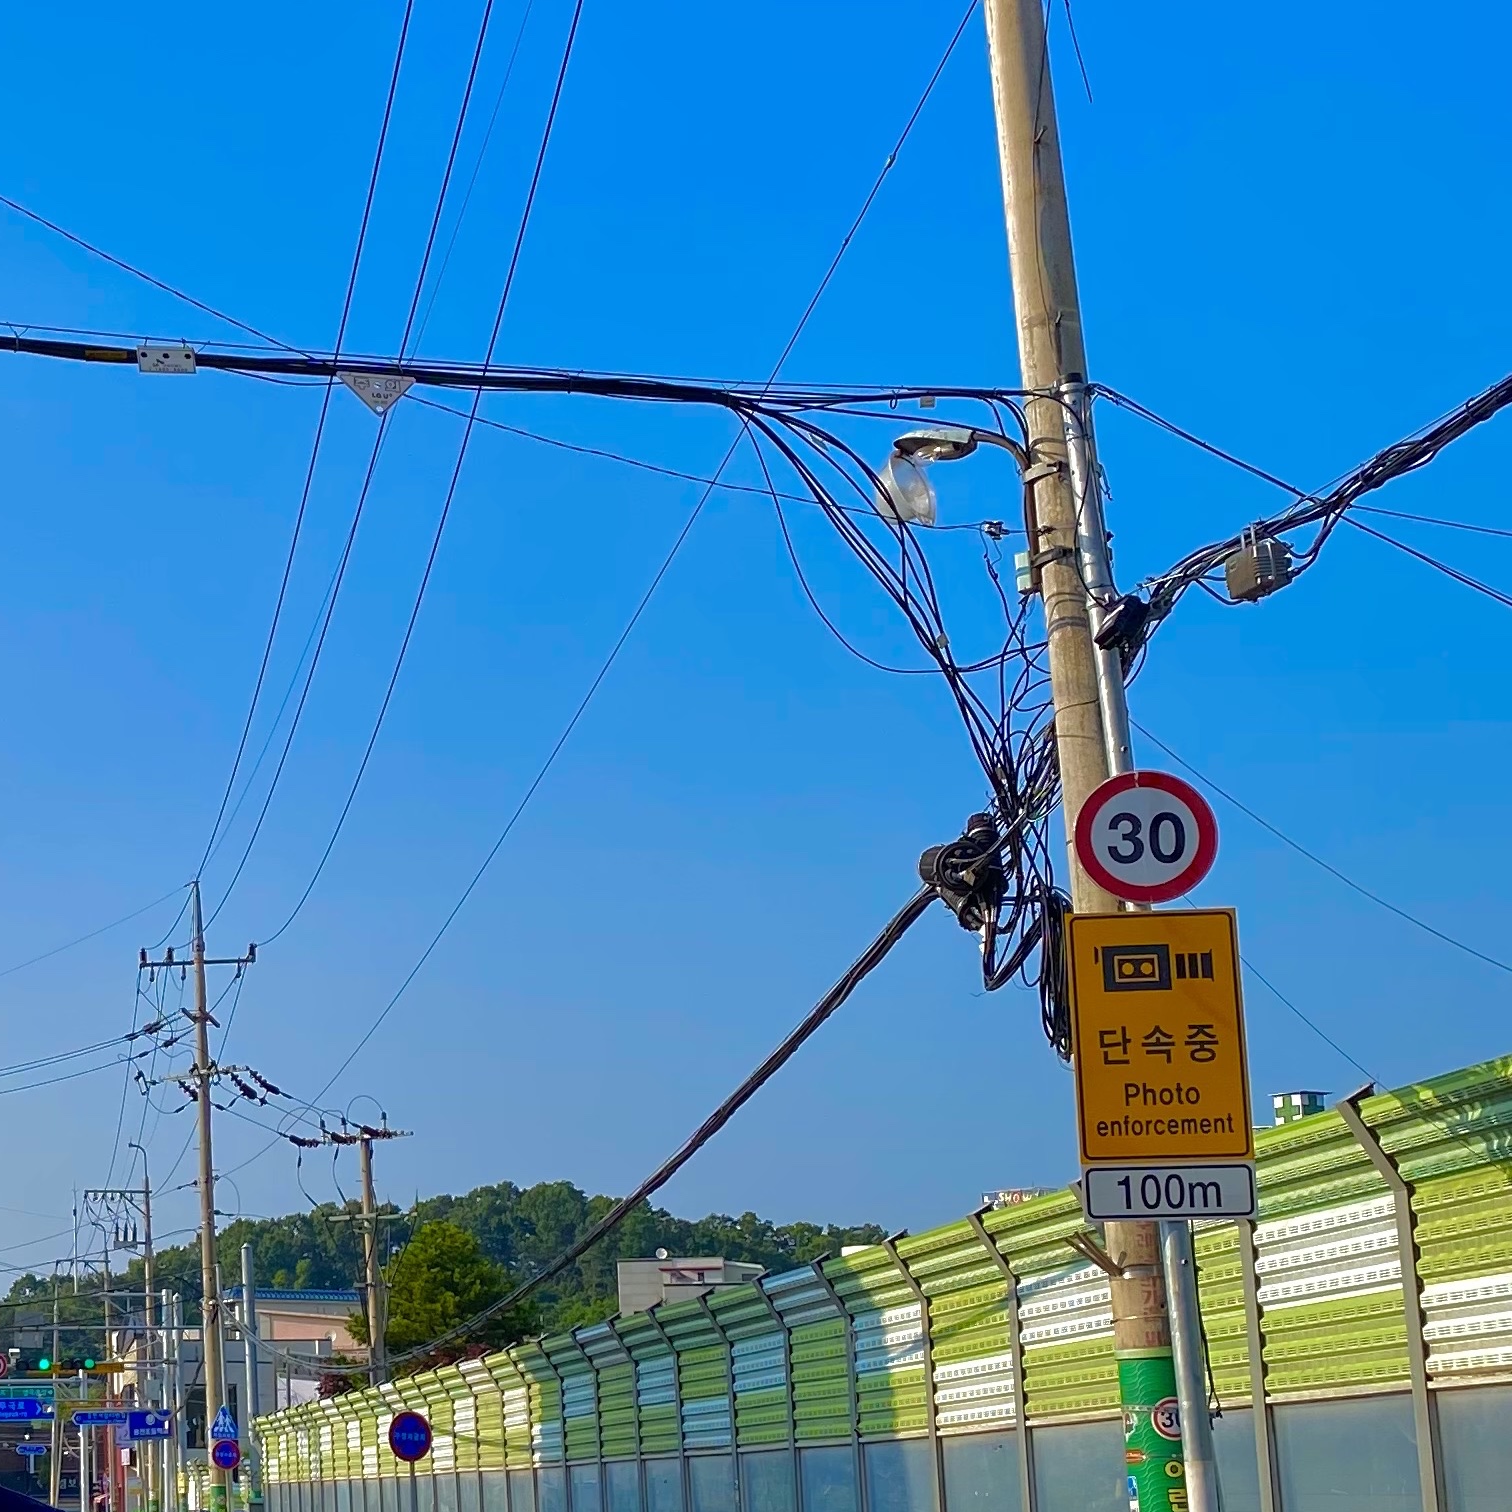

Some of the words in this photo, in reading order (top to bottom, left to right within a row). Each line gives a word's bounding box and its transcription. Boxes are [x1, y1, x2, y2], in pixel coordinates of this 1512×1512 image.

[1107, 812, 1186, 865] 30
[1098, 1023, 1219, 1066] 단속중
[1123, 1082, 1201, 1107] Photo
[1096, 1113, 1235, 1137] enforcement
[1116, 1173, 1223, 1210] 100m
